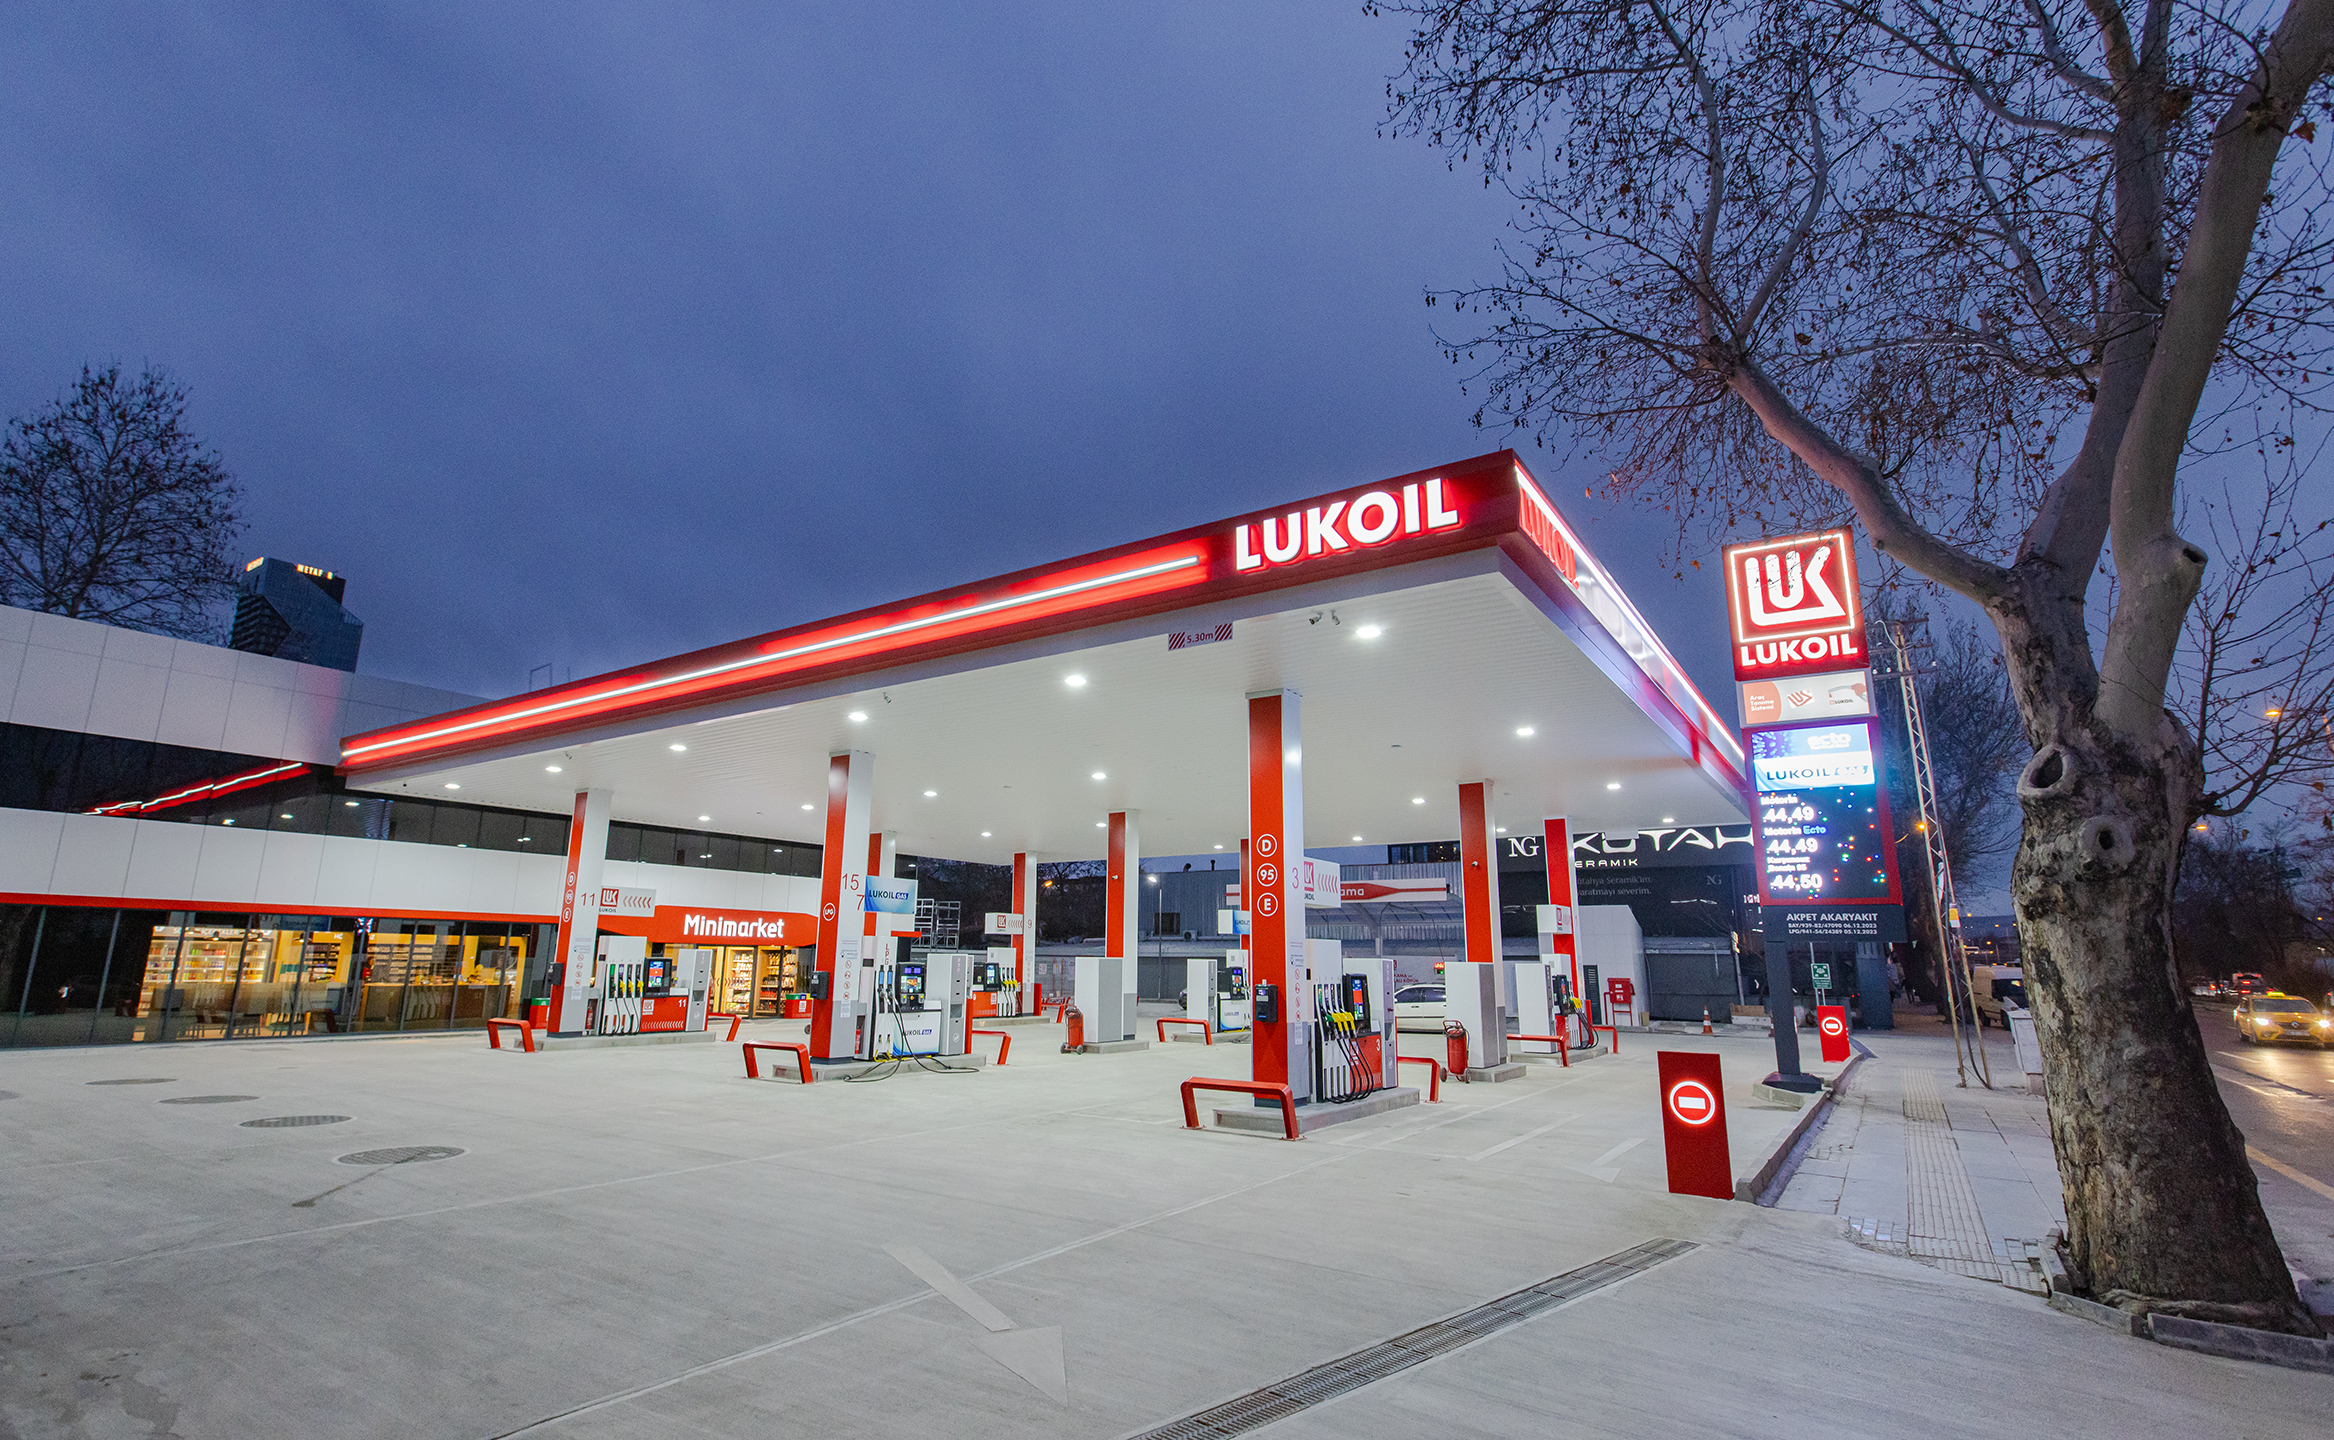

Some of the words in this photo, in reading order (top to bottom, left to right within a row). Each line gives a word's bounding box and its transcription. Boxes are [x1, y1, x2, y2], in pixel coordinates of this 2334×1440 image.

[1236, 478, 1459, 571] LUKOIL
[296, 564, 334, 580] METAFR
[1745, 546, 1847, 627] LUK
[1186, 632, 1214, 644] 5.30m
[1741, 633, 1858, 667] LUKOIL
[1766, 768, 1831, 781] LUKOIL
[1763, 806, 1815, 824] 44,49
[1803, 825, 1826, 835] Ecto
[1262, 840, 1272, 852] D
[1508, 836, 1540, 858] NG
[1767, 837, 1819, 856] 44,49
[842, 873, 860, 891] 15
[1260, 869, 1275, 881] 95
[1291, 867, 1300, 889] 3
[1771, 873, 1823, 891] 44,50
[581, 892, 596, 907] 11
[868, 889, 895, 899] LUKOIL
[896, 892, 907, 900] GAS
[857, 894, 865, 911] 7
[1264, 898, 1272, 911] E
[1027, 919, 1033, 929] 9
[1786, 913, 1818, 921] AKPET
[1820, 913, 1878, 921] AKARYAKIT
[683, 913, 785, 939] Minimarket
[677, 999, 687, 1008] 11
[1375, 1039, 1381, 1051] 3
